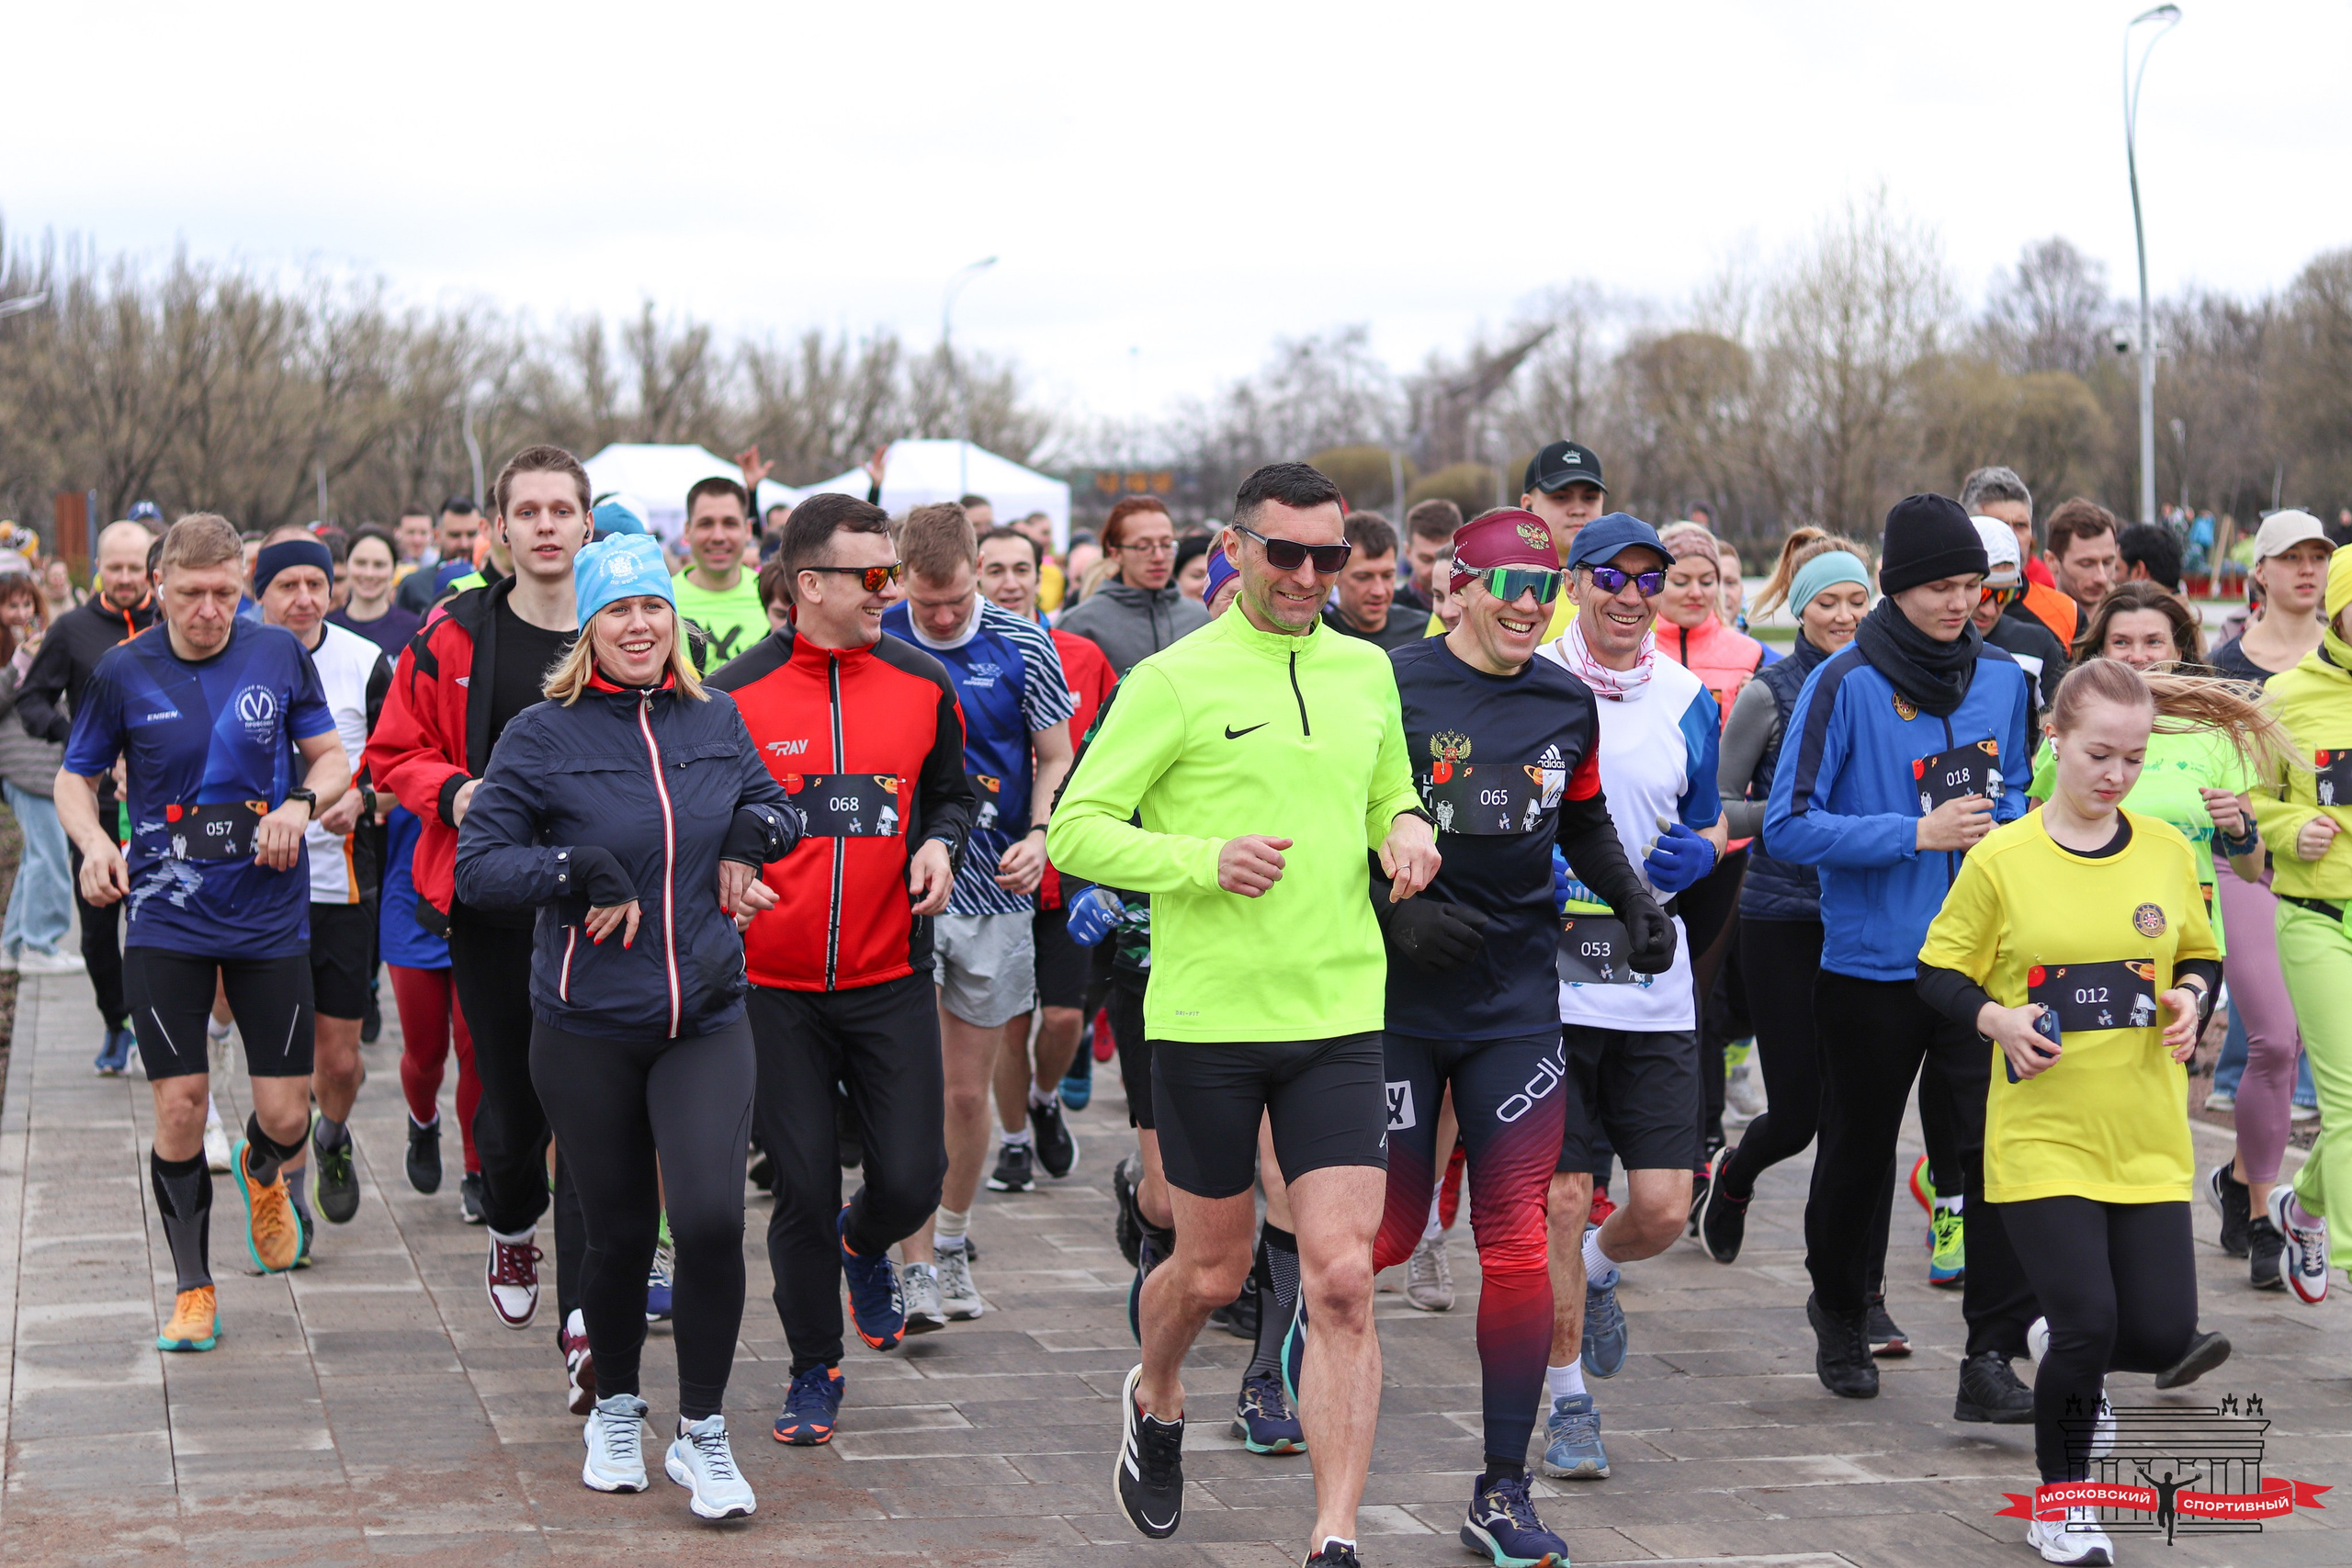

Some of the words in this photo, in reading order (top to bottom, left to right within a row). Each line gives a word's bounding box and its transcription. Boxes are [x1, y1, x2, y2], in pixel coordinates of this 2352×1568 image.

[766, 739, 808, 756] RAY
[1946, 767, 1971, 787] 018
[830, 796, 860, 812] 068
[1480, 789, 1509, 806] 065
[206, 819, 233, 837] 057
[1580, 942, 1611, 957] 053
[2075, 987, 2109, 1004] 012
